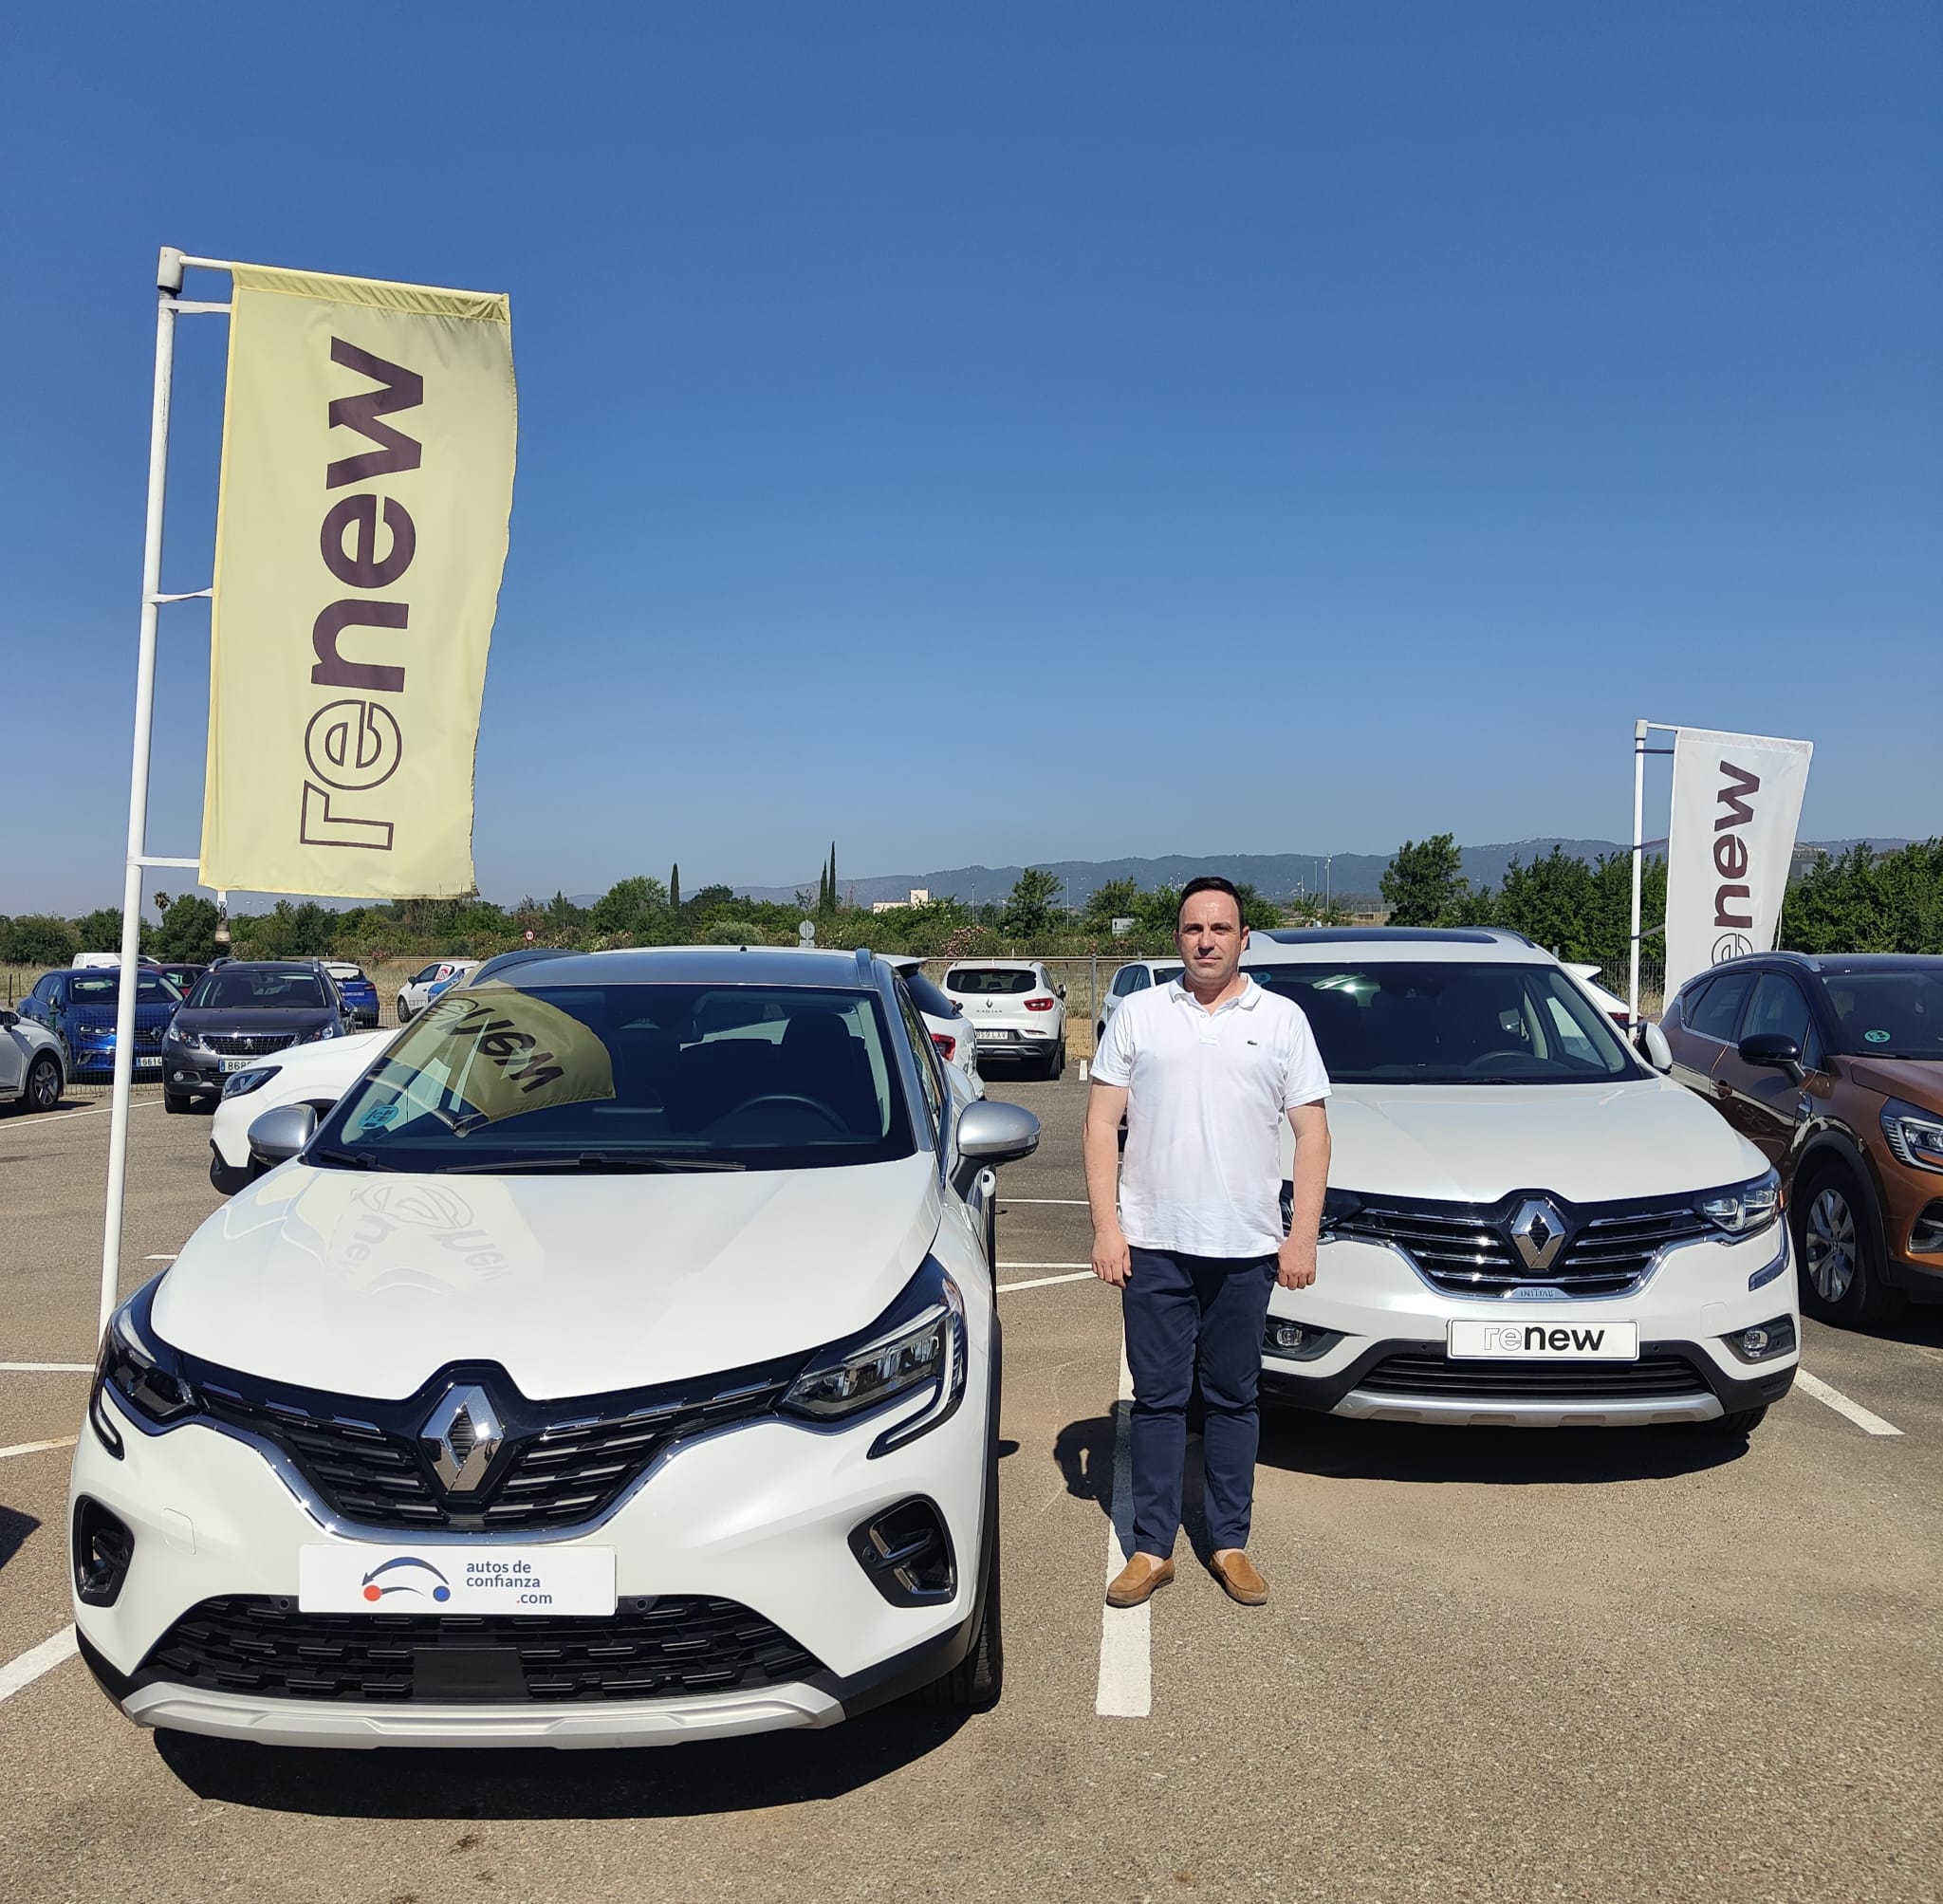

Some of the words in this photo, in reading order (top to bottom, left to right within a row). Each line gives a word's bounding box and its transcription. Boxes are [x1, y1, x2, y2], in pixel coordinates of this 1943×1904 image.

[300, 335, 424, 851] renew
[1711, 760, 1761, 966] enew
[228, 1061, 251, 1071] 868
[1484, 1326, 1605, 1352] renew
[466, 1562, 509, 1573] autos
[512, 1560, 531, 1573] de
[466, 1574, 541, 1587] confianza
[515, 1593, 552, 1604] .com
